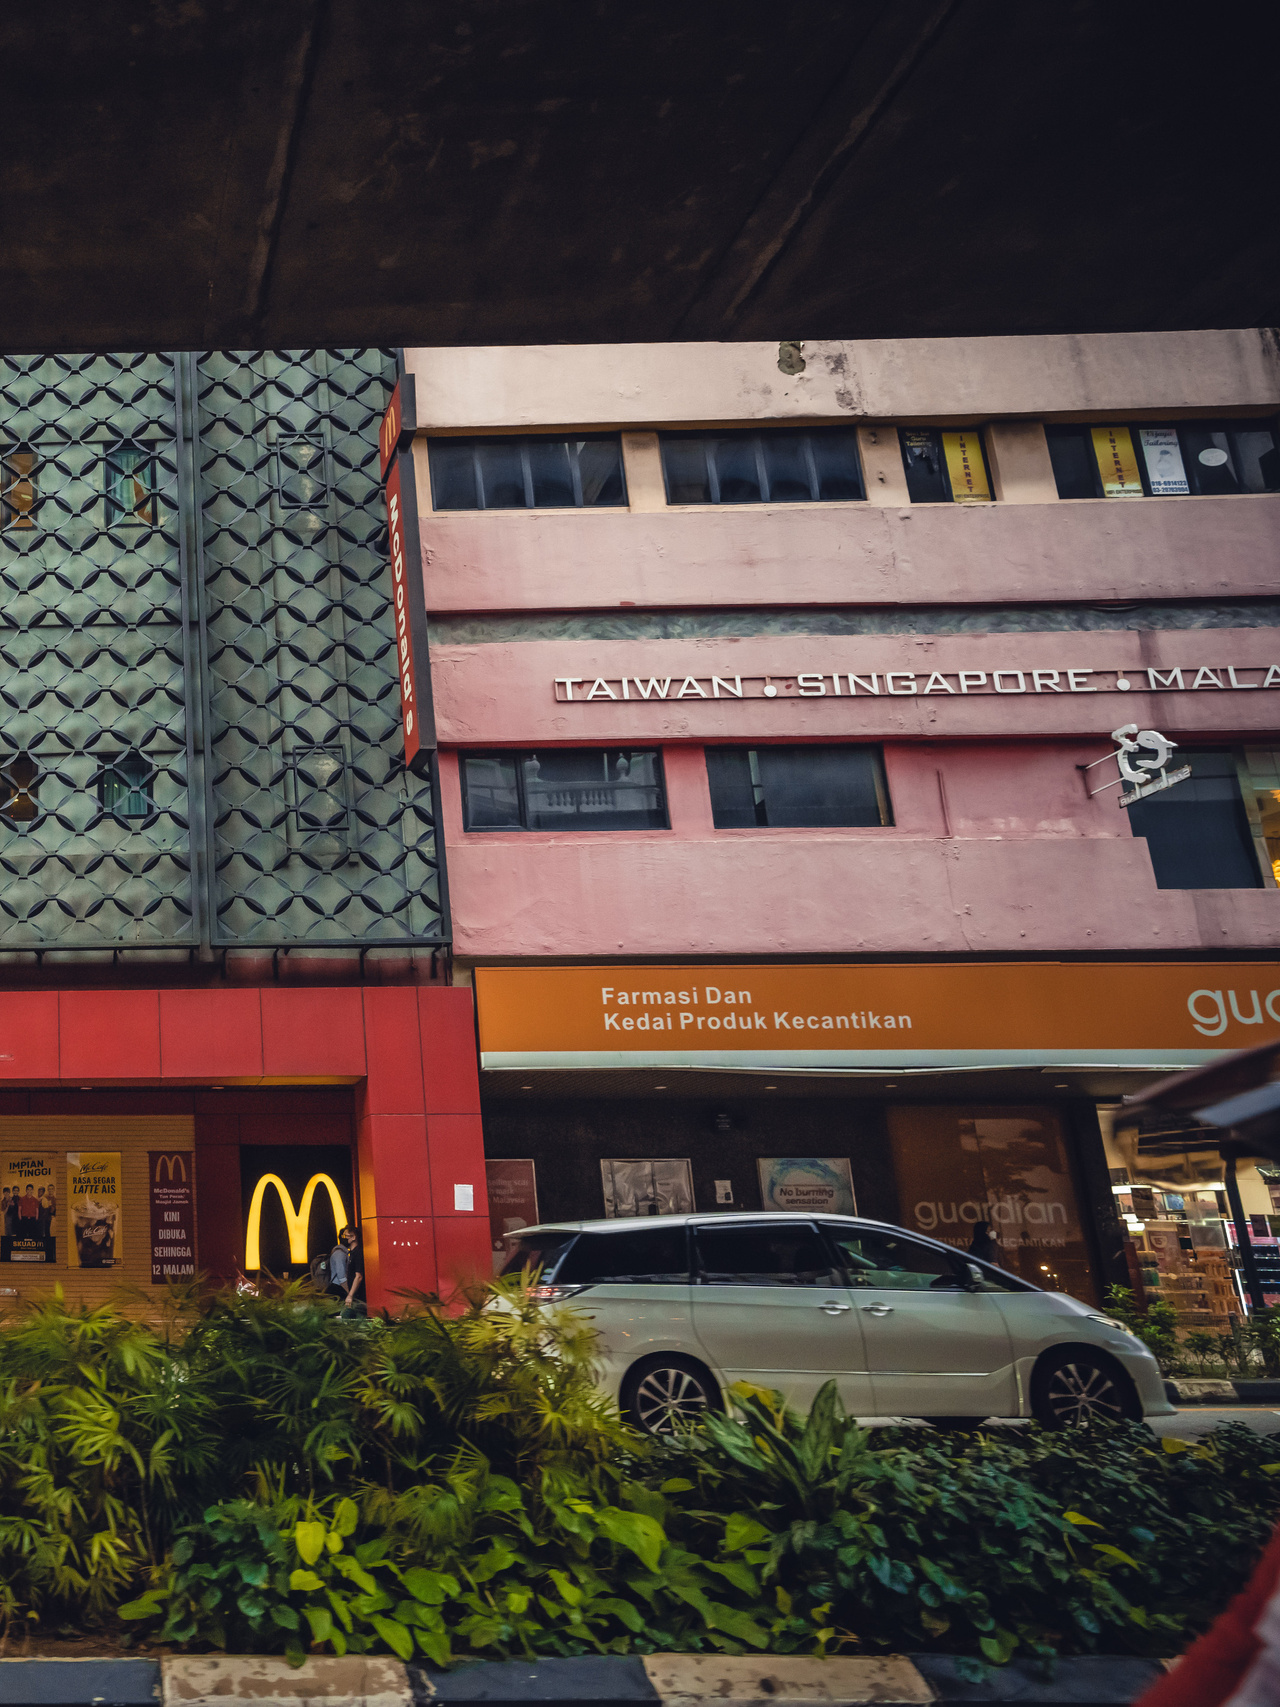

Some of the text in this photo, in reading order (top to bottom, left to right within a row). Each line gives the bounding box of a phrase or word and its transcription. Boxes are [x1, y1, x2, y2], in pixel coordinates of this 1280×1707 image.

[960, 435, 974, 493] INTERNET
[1108, 430, 1126, 488] INTERNET
[389, 494, 414, 737] McDonald's
[555, 675, 743, 701] TAIWAN
[797, 668, 1098, 696] SINGAPORE
[601, 986, 752, 1005] Farmasi Dan
[604, 1011, 912, 1031] Kedai Produk Kecantikan
[9, 1160, 44, 1170] IMPIAN
[18, 1168, 51, 1177] TINGGI
[73, 1185, 116, 1194] LATTE AIS
[780, 1187, 793, 1196] No
[785, 1197, 829, 1205] sensation
[164, 1211, 180, 1222] KINI
[914, 1195, 1068, 1230] guardian
[158, 1229, 186, 1240] DIBUKA
[154, 1246, 192, 1258] SEHINGGA
[152, 1264, 194, 1275] 12 MALAM
